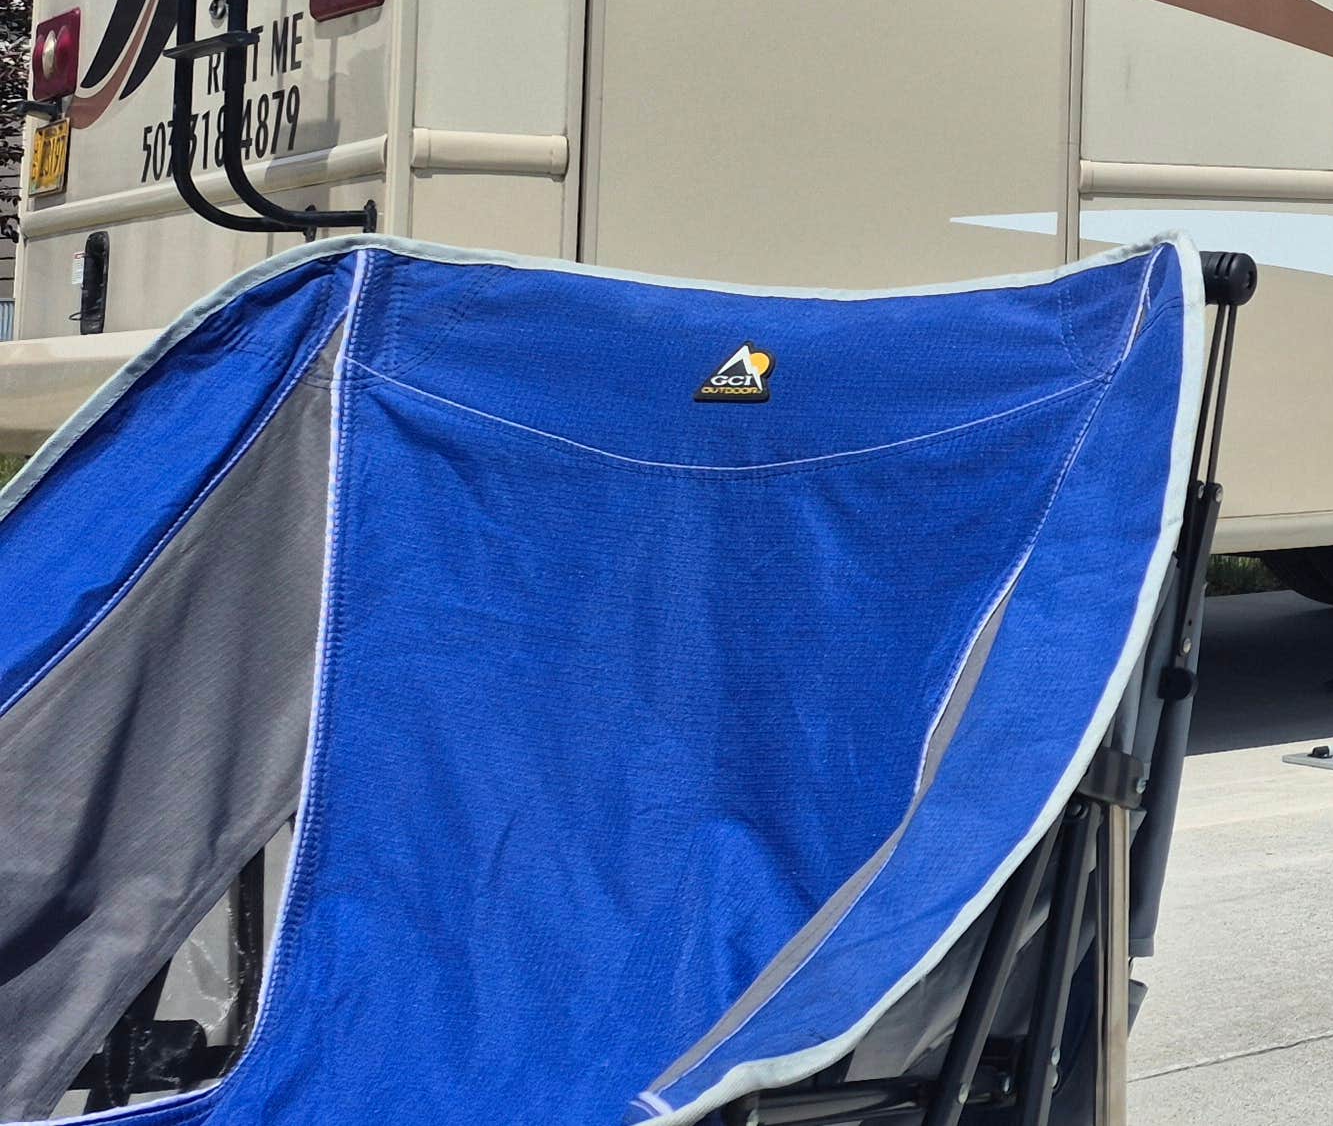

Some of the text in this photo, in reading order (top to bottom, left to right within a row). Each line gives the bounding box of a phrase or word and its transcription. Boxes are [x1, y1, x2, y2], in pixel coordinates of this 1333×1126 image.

[207, 12, 304, 95] RT ME
[710, 375, 753, 386] GCI
[701, 386, 759, 394] OUTDOOR
